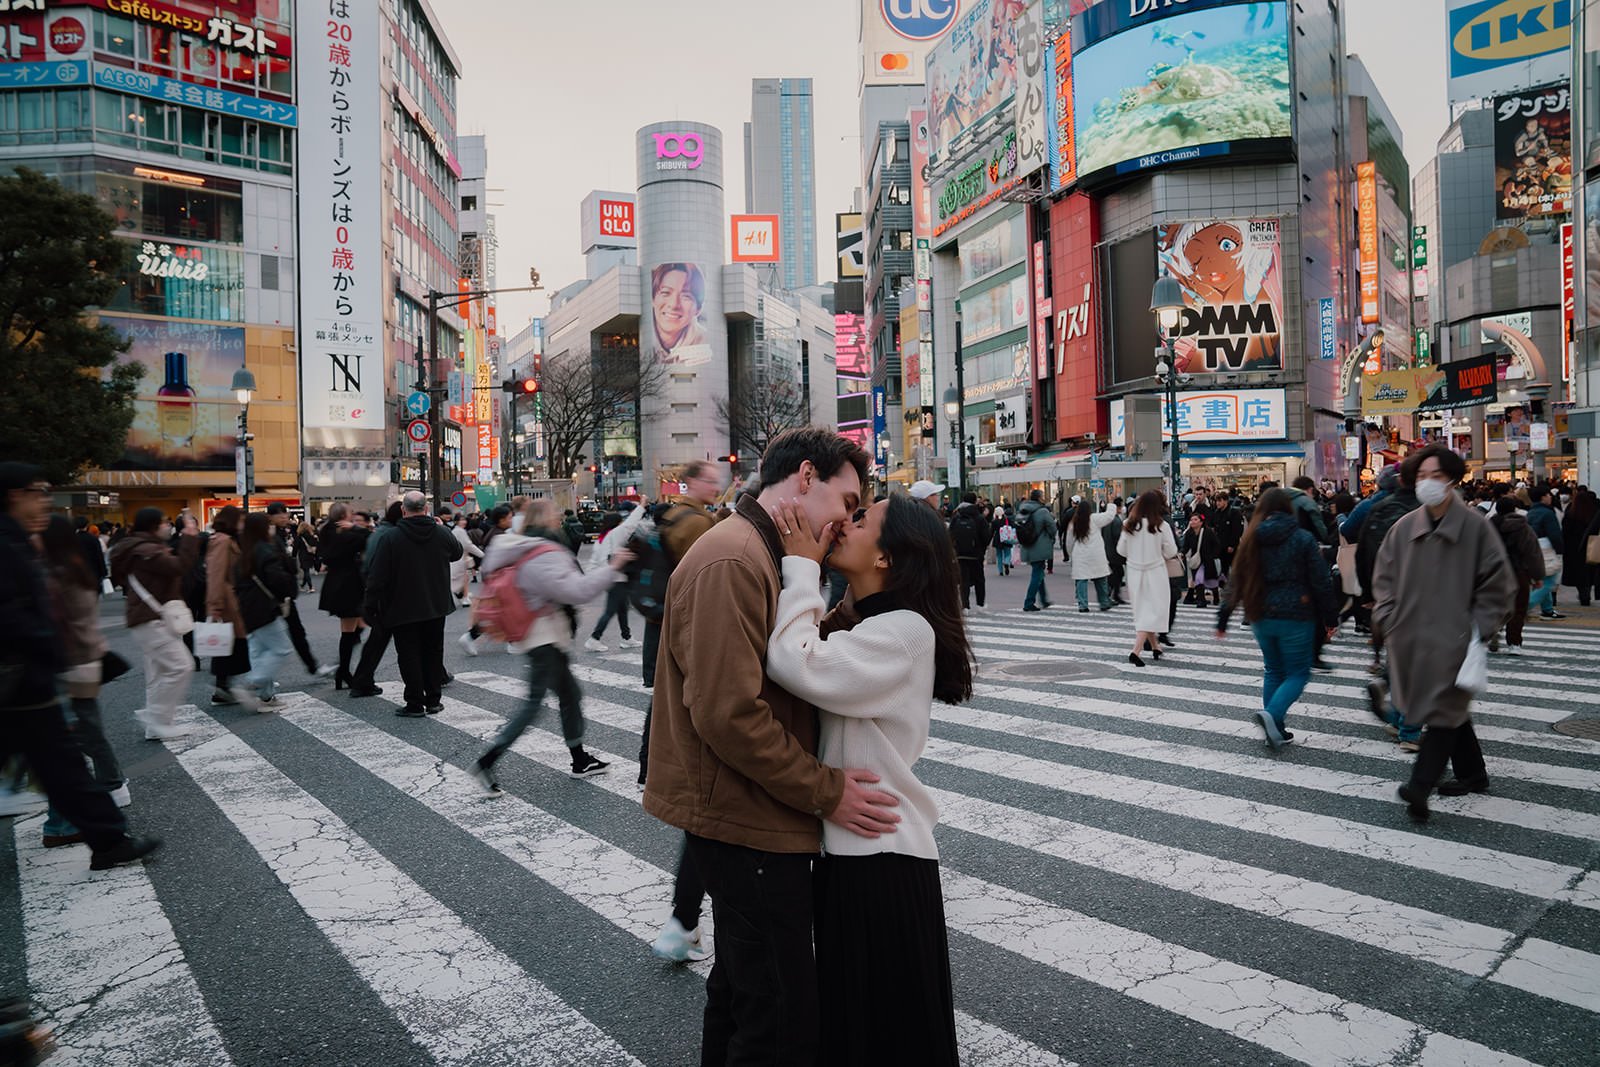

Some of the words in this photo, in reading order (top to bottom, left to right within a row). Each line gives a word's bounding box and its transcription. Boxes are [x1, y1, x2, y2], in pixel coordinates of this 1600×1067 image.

[54, 33, 82, 45] ガスト
[208, 17, 277, 54] ガスト
[102, 68, 151, 92] AEON
[164, 80, 294, 122] 英会話イーオン
[652, 132, 704, 169] 109
[656, 161, 687, 170] SHIBUYA
[1139, 156, 1160, 168] DHC
[1162, 148, 1200, 163] Channel
[603, 204, 629, 219] UNI
[603, 219, 631, 234] QLO
[1057, 282, 1091, 375] クスリ
[1169, 303, 1277, 337] DMM
[1198, 337, 1248, 368] TV
